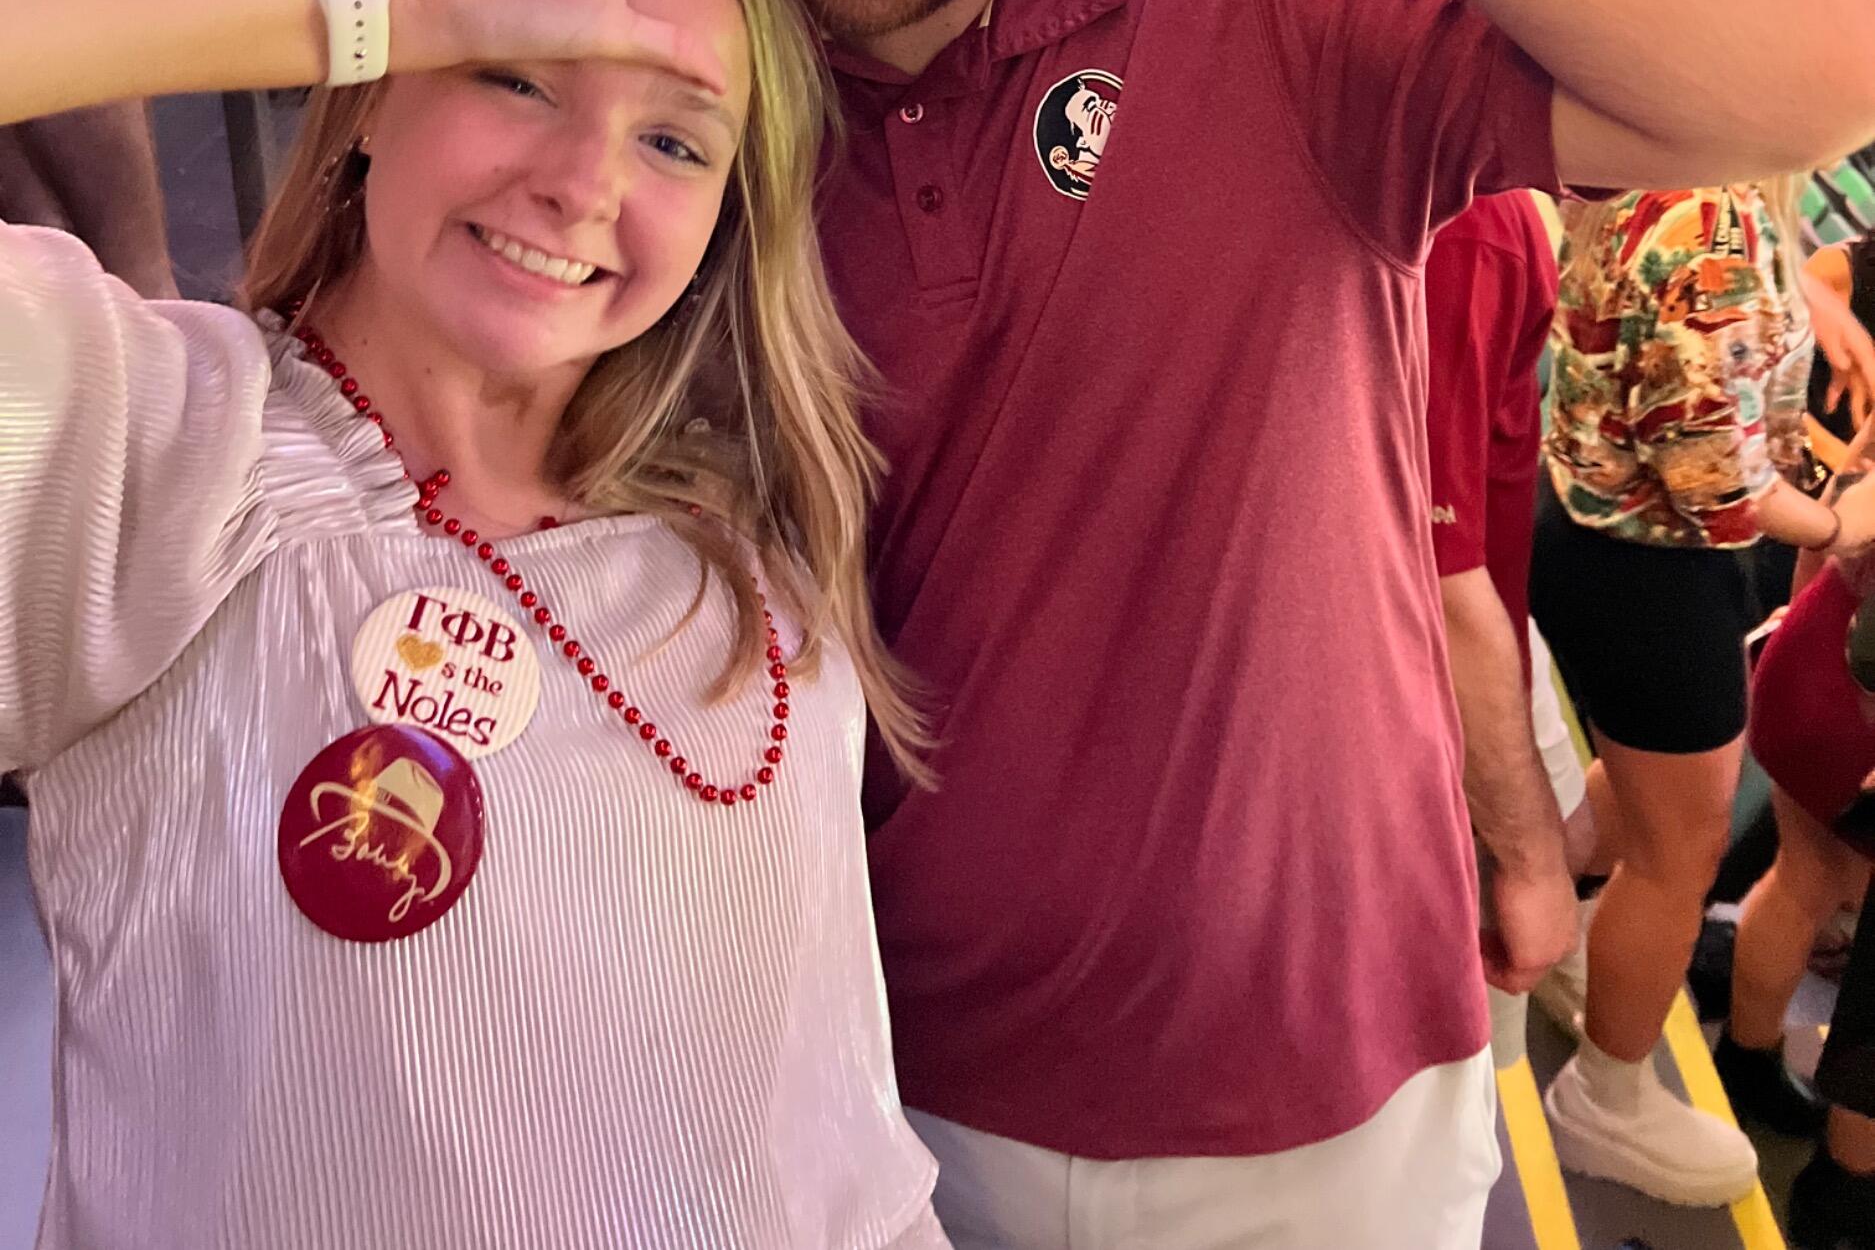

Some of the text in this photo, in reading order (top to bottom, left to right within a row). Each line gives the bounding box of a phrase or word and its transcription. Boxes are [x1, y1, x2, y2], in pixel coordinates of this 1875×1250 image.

[440, 661, 503, 695] s the
[371, 667, 497, 747] Noles
